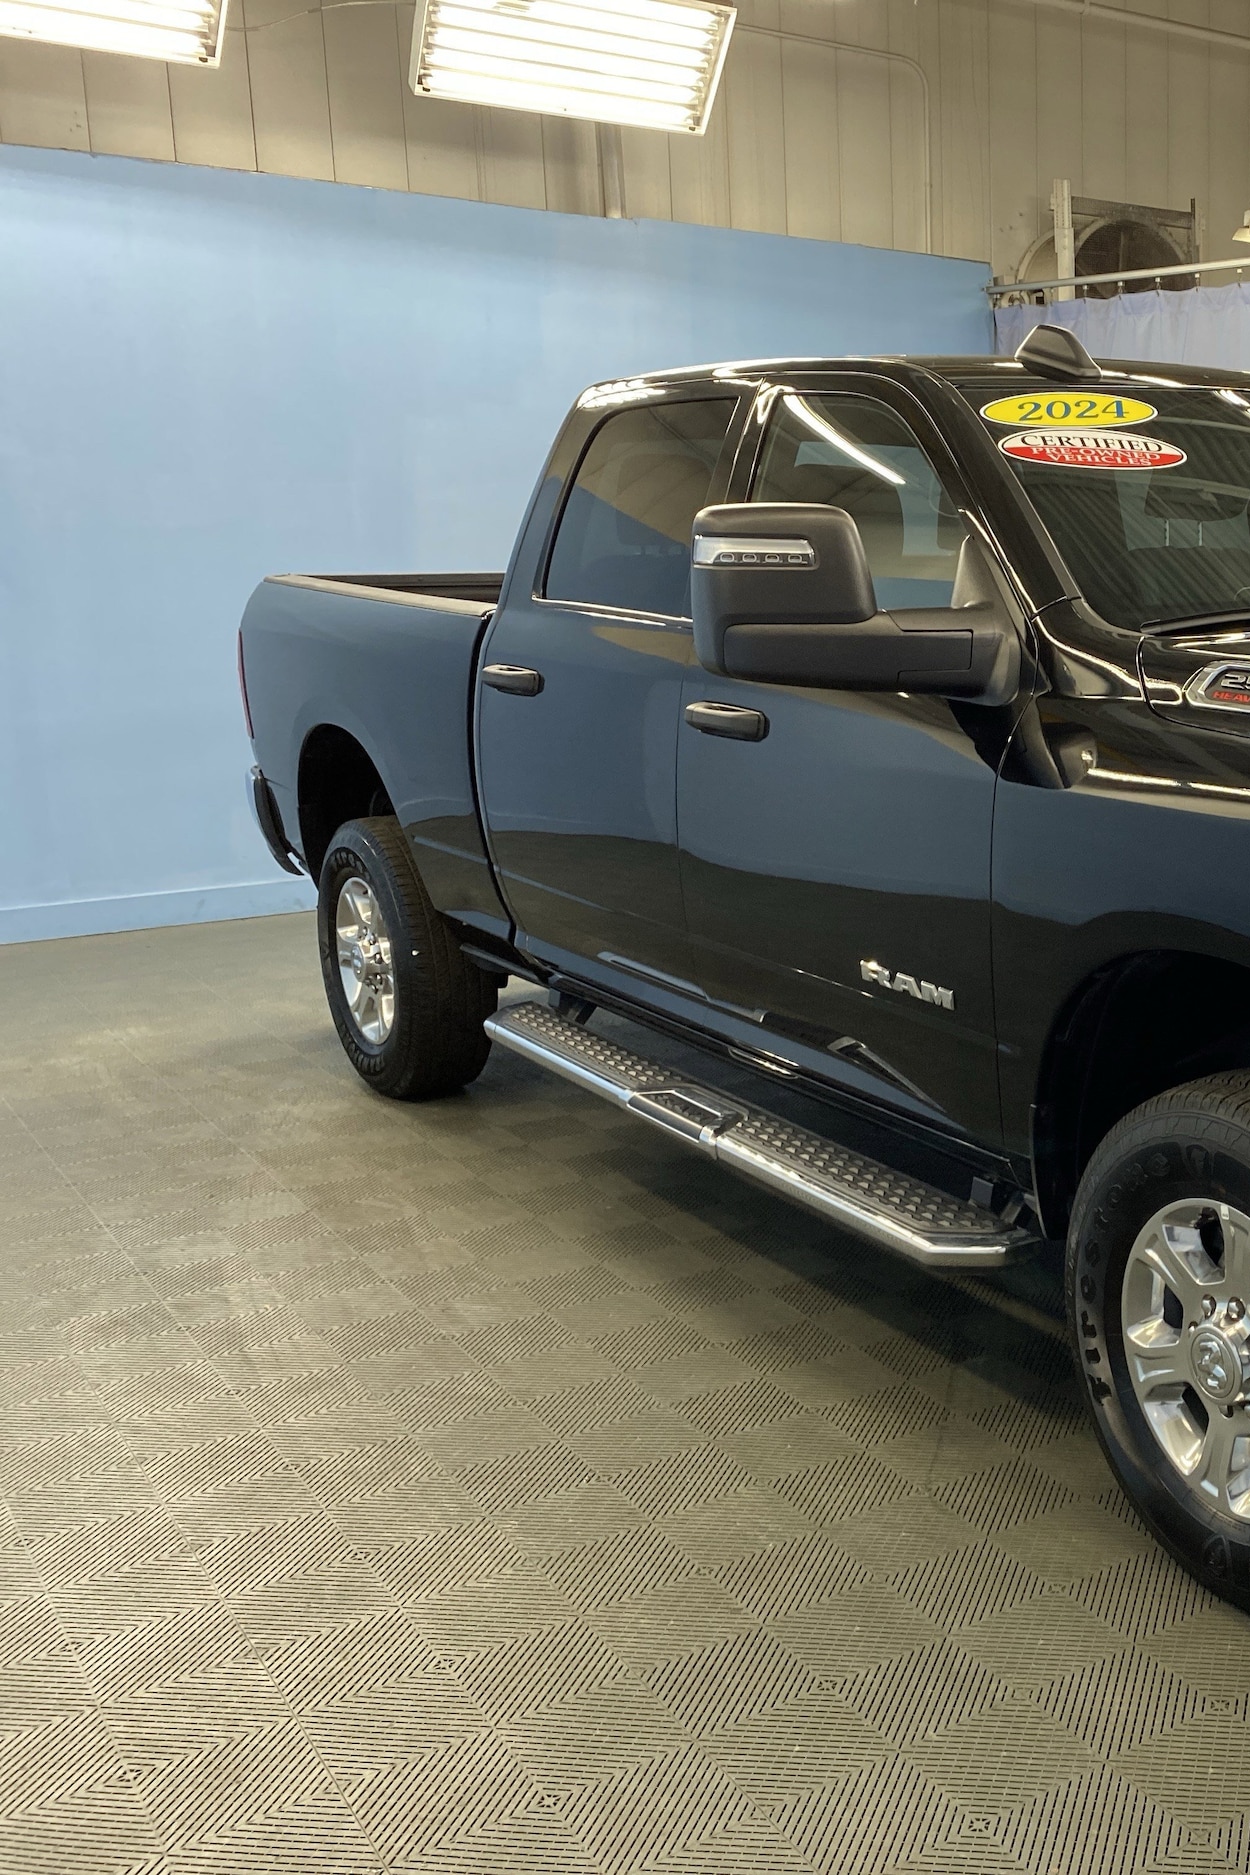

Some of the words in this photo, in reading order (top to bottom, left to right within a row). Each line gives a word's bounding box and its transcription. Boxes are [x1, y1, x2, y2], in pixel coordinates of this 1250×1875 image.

[1017, 400, 1130, 421] 2024
[1020, 434, 1163, 452] CERTIFIED
[1030, 446, 1161, 461] PRE-OWNED
[1047, 453, 1152, 466] VEHICLES
[859, 959, 955, 1011] RAM
